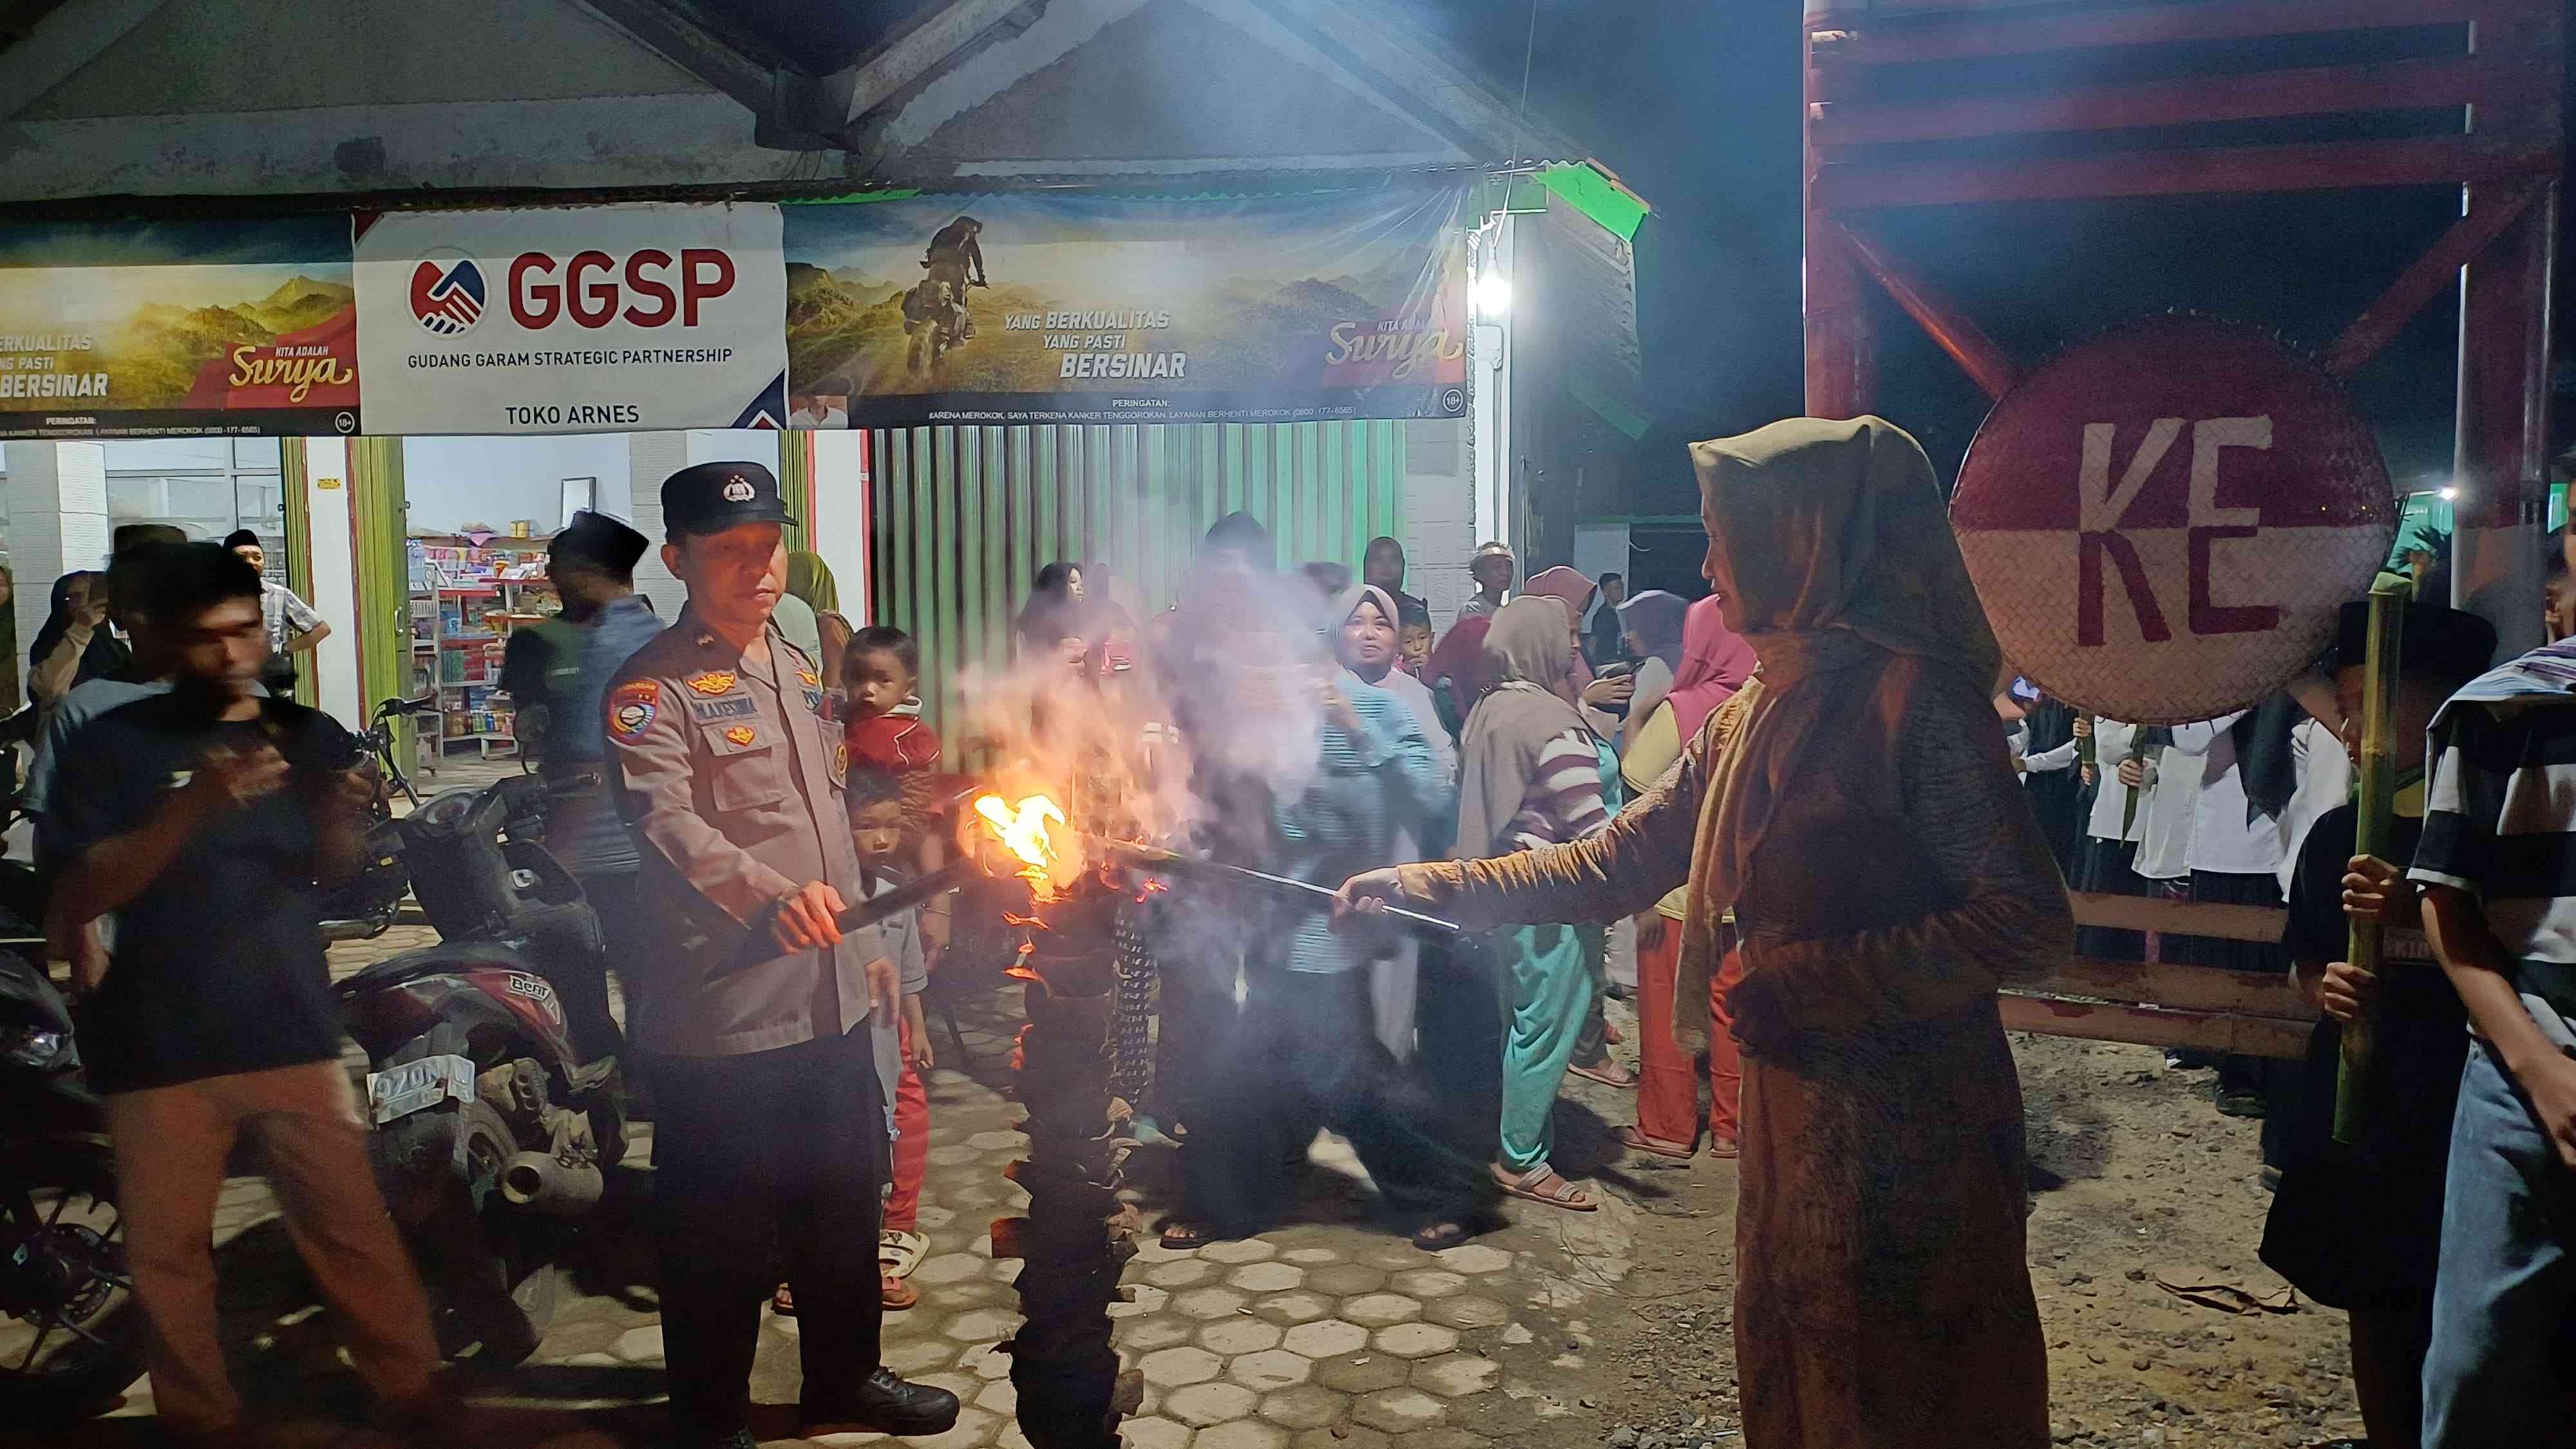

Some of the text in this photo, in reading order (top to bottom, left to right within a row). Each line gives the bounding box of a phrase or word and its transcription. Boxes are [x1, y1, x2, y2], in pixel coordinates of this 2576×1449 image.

[508, 248, 736, 330] GGSP
[1005, 309, 1170, 330] YANG BERKUALITAS
[275, 346, 329, 357] KITA ADALAH
[1043, 334, 1126, 350] YANG PASTI
[1325, 322, 1464, 380] Surya
[18, 356, 54, 370] PASTI
[408, 348, 732, 368] GUDANG GARAM STRATEGIC PARTNERSHIP
[1060, 352, 1186, 379] BERSINAR
[229, 345, 353, 402] Surya
[0, 372, 109, 397] BERSINAR
[1112, 399, 1171, 407] PERINGATAN:
[1446, 396, 1461, 405] 18+
[505, 405, 639, 424] TOKO ARNES
[1208, 409, 1248, 417] BERHENTI
[1250, 408, 1291, 417] MEROKOK
[338, 419, 351, 427] 18+
[2077, 413, 2283, 647] KE
